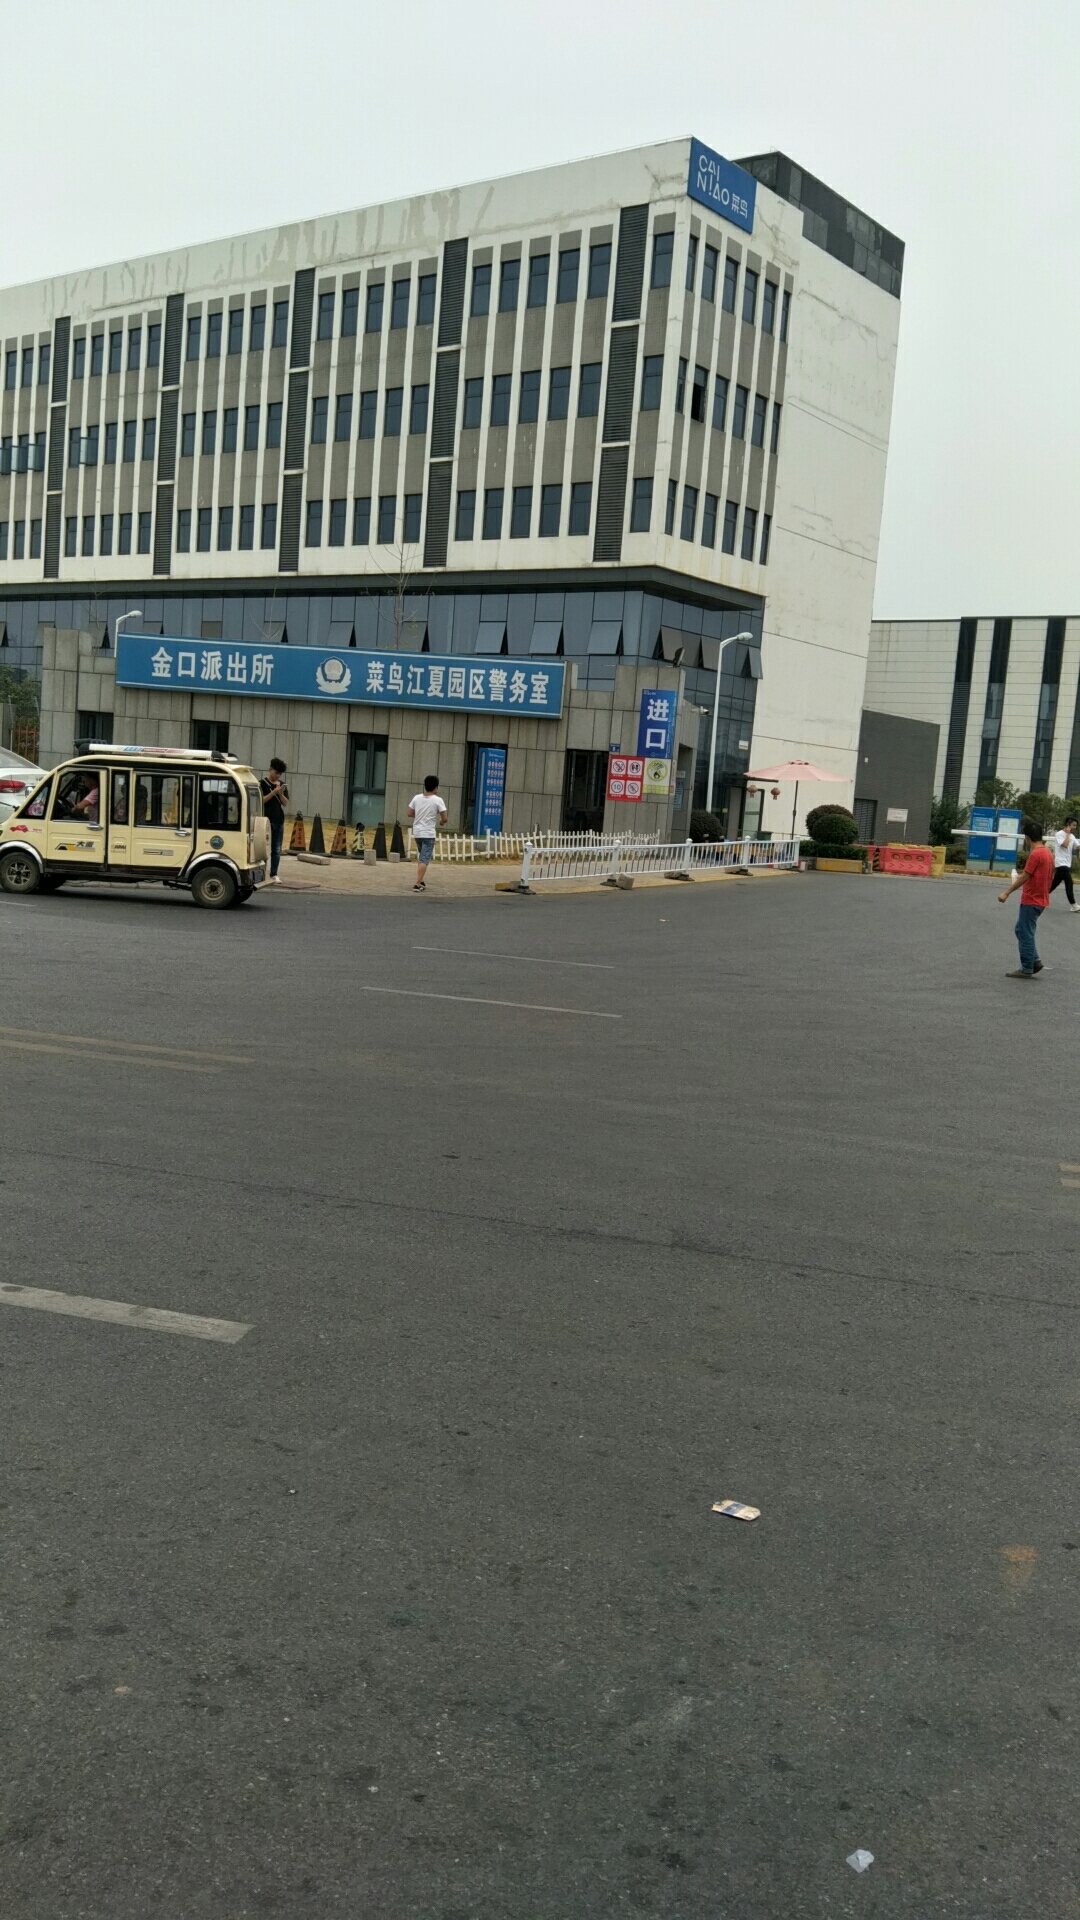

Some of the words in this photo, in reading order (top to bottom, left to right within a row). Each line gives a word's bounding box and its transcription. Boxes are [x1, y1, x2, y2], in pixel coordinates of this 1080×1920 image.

[699, 154, 720, 182] CAI
[731, 193, 748, 218] 菜鸟
[151, 646, 274, 686] 金口派出所
[366, 661, 549, 704] 菜鸟江夏园区警务室
[645, 699, 669, 749] 进口
